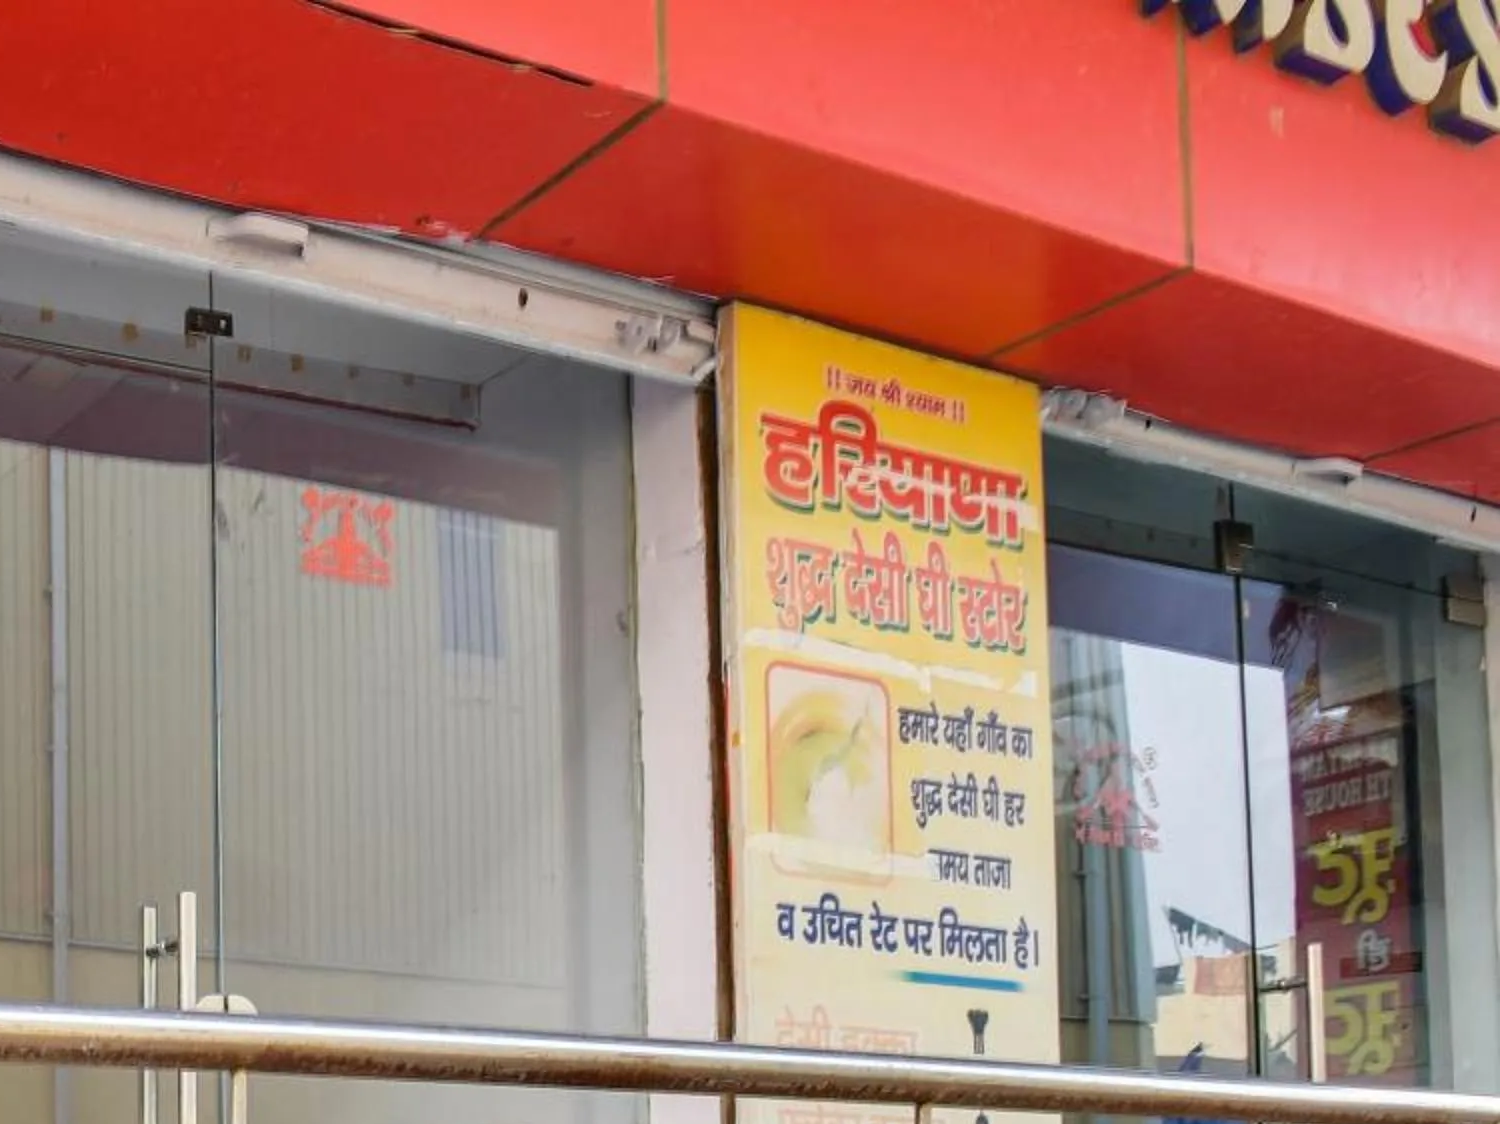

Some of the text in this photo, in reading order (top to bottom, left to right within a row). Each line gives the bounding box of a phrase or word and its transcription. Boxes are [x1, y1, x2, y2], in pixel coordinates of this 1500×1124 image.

[898, 702, 940, 745] हमारे
[1012, 727, 1033, 759] का
[911, 773, 1025, 829] शुद्ध देसी घी हर
[777, 903, 795, 941] व
[803, 893, 863, 948] उचित
[869, 902, 899, 953] रेट
[904, 916, 935, 956] पर
[939, 907, 1007, 965] मिलता
